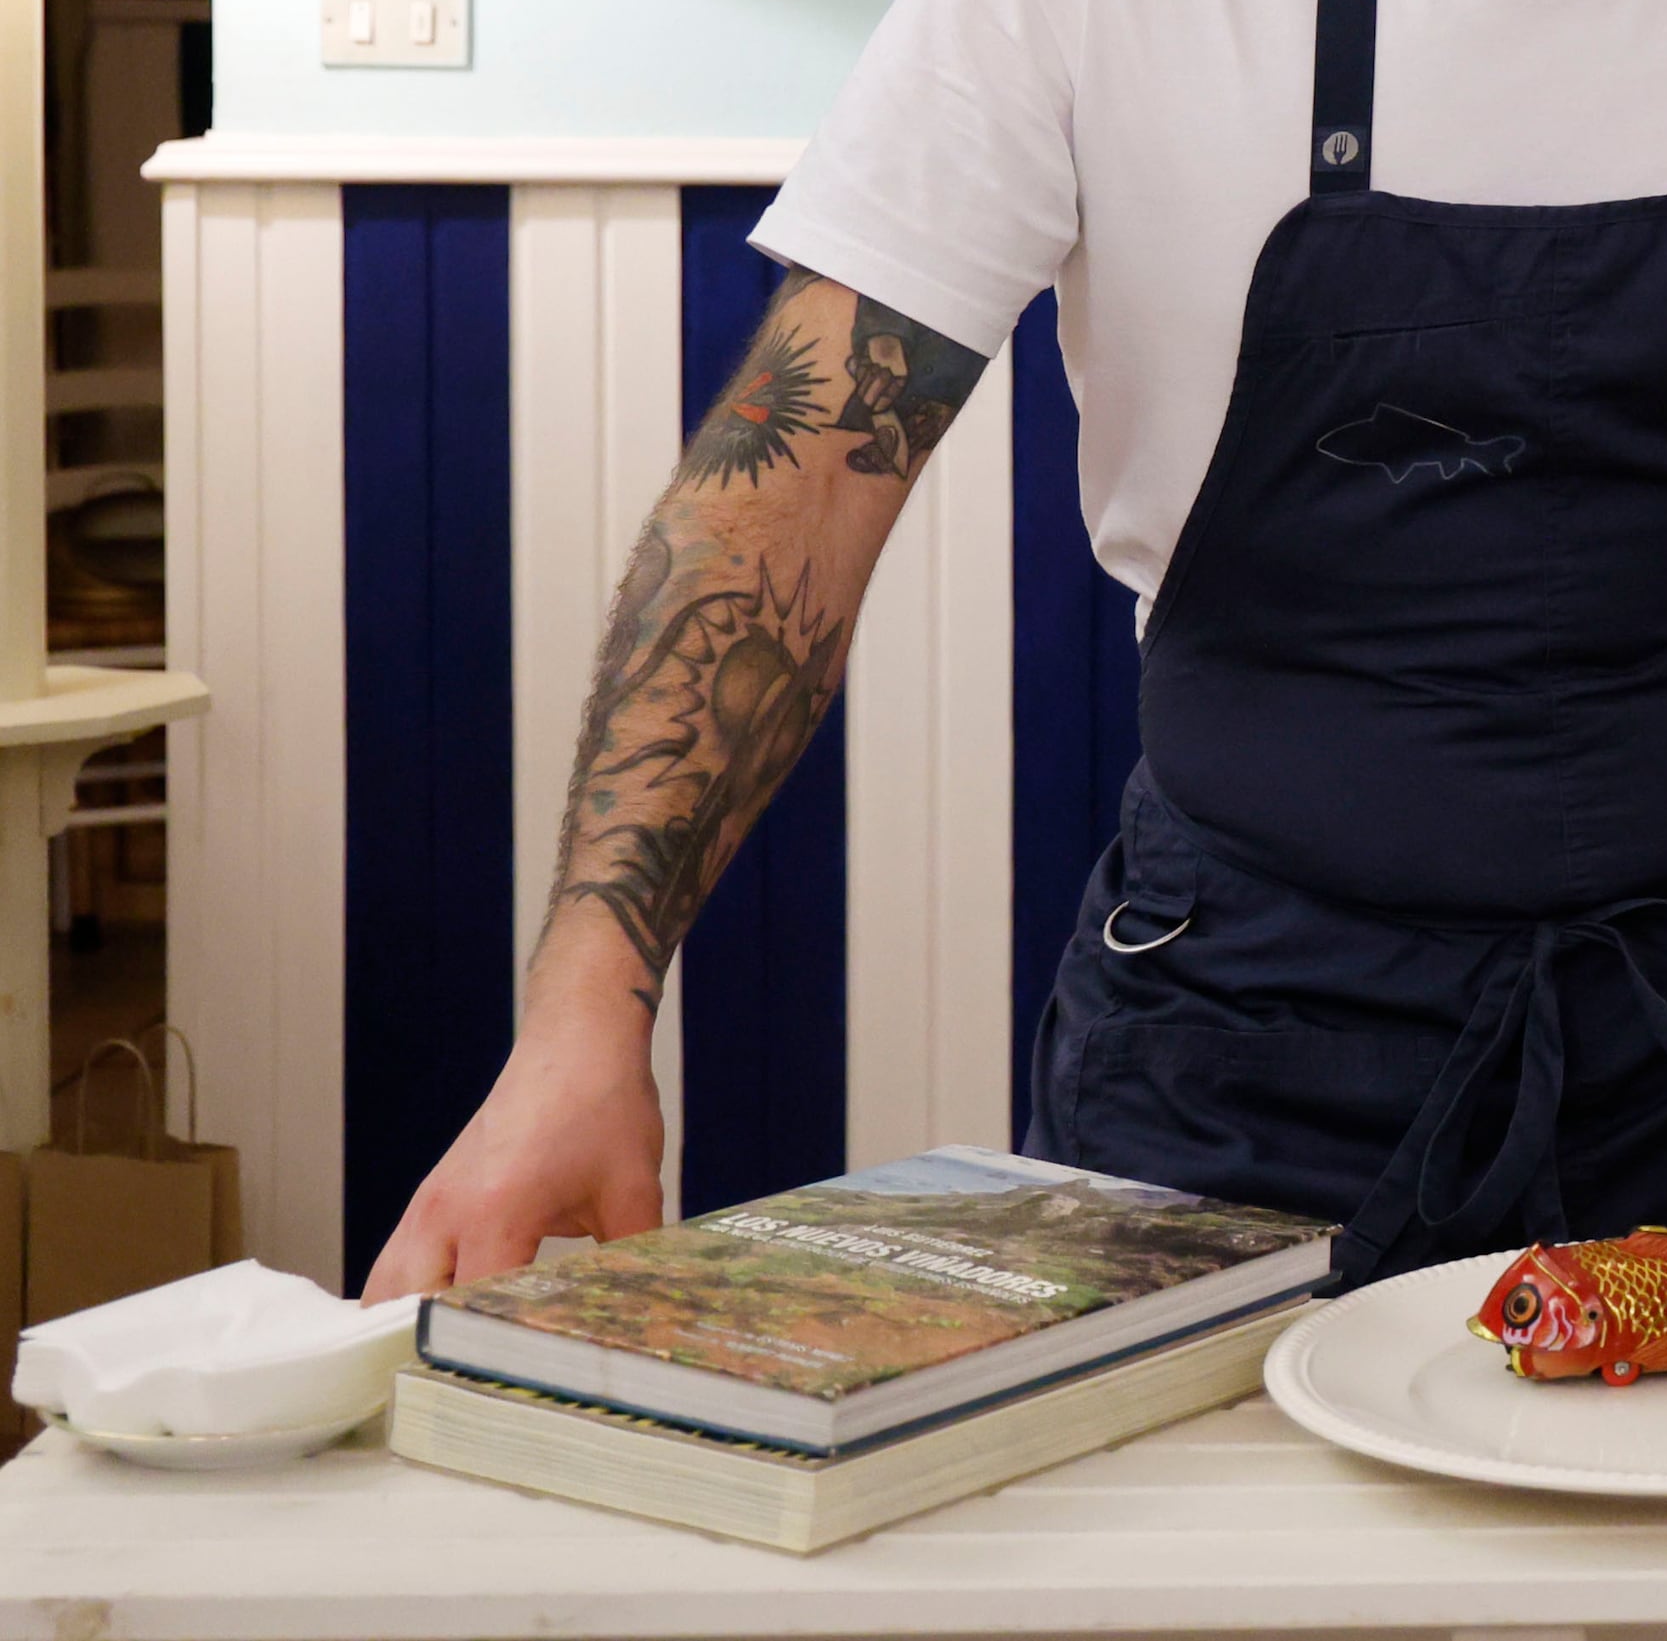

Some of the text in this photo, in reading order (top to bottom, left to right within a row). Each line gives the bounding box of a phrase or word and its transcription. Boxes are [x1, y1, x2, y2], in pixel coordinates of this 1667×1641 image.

[717, 1212, 789, 1232] LOS
[775, 1224, 903, 1258] NUEVOS
[893, 1249, 1069, 1299] VIÑADORES
